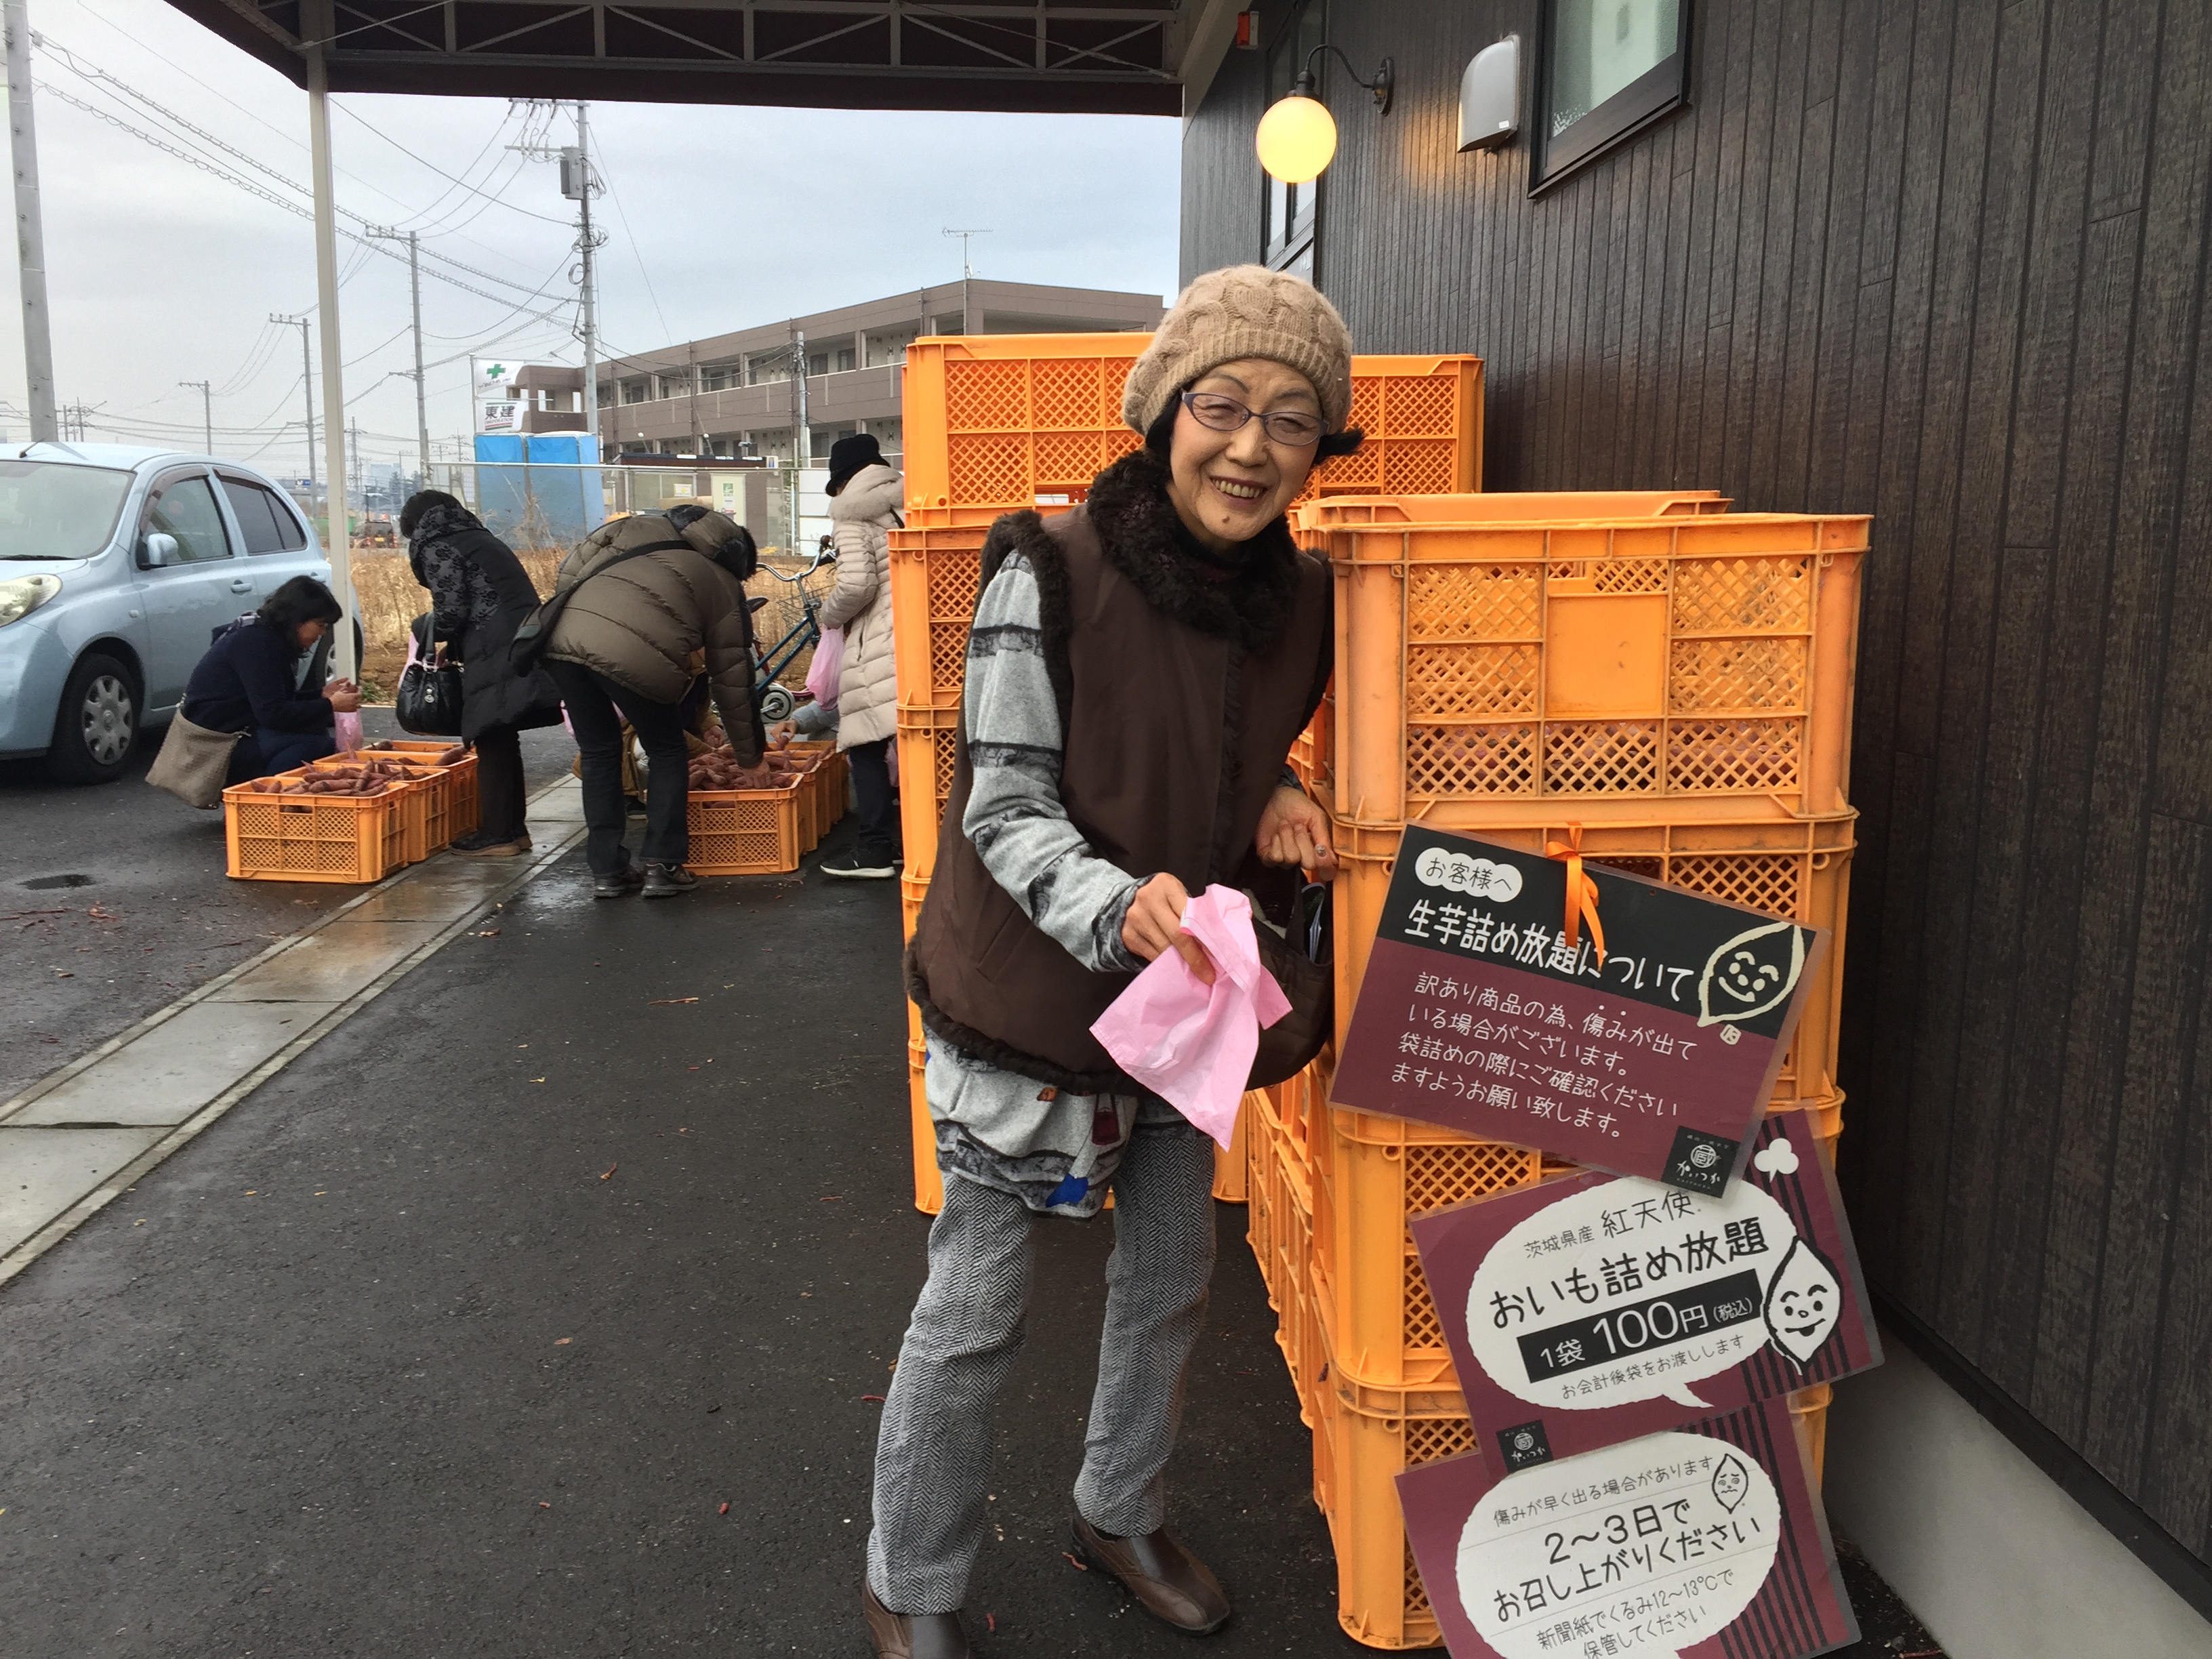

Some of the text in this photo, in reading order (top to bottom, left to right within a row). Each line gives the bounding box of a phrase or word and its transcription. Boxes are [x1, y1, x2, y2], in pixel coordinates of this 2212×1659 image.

[485, 405, 515, 419] 東建
[1425, 857, 1512, 891] お客様へ
[1404, 899, 1694, 1002] 生芋詰め放題について
[1408, 1004, 1626, 1076] いる場合がございます。
[1414, 971, 1698, 1060] 訳あり商品の為、傷みが出て
[1391, 1062, 1620, 1137] ますようお願い致します。
[1397, 1031, 1677, 1116] 袋詰めの際にご確認ください
[1523, 1191, 1695, 1258] 茨城県産 紅天使
[1490, 1216, 1769, 1329] おいも詰め放題
[1540, 1338, 1586, 1368] 1袋
[1593, 1300, 1708, 1355] 100円
[1561, 1334, 1744, 1400] お会計後袋をお渡しします
[1494, 1456, 1713, 1528] 傷みが早く出る場合があります
[1494, 1517, 1761, 1622] お召し上がりください
[1584, 1605, 1706, 1659] 保管してください
